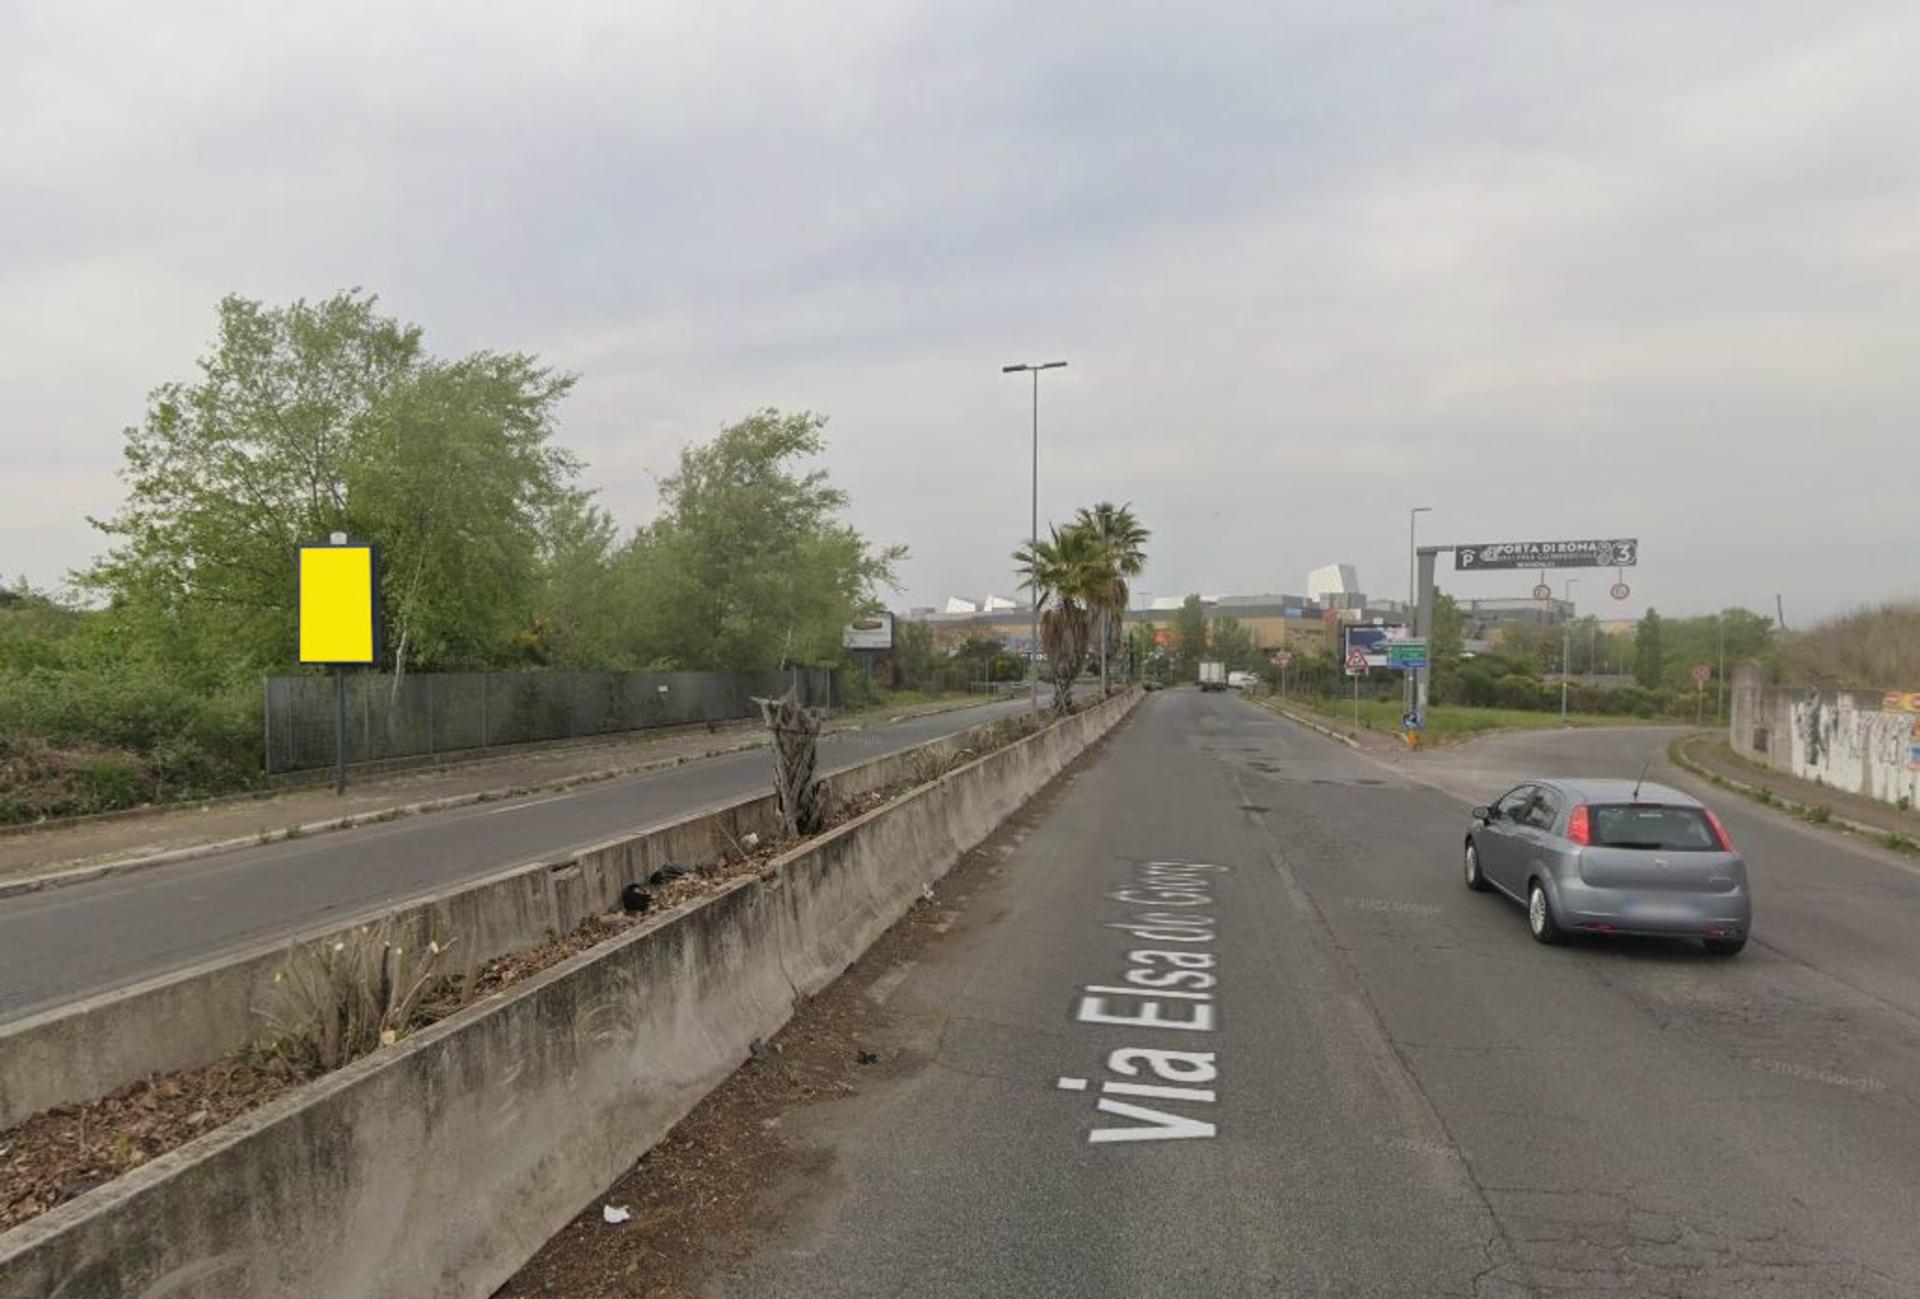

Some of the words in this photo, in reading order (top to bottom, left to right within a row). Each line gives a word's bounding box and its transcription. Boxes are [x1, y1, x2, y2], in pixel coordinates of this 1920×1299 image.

[1498, 543, 1541, 554] PORTA
[1543, 543, 1556, 553] DI
[1558, 542, 1597, 553] ROMA
[1617, 544, 1631, 562] 3
